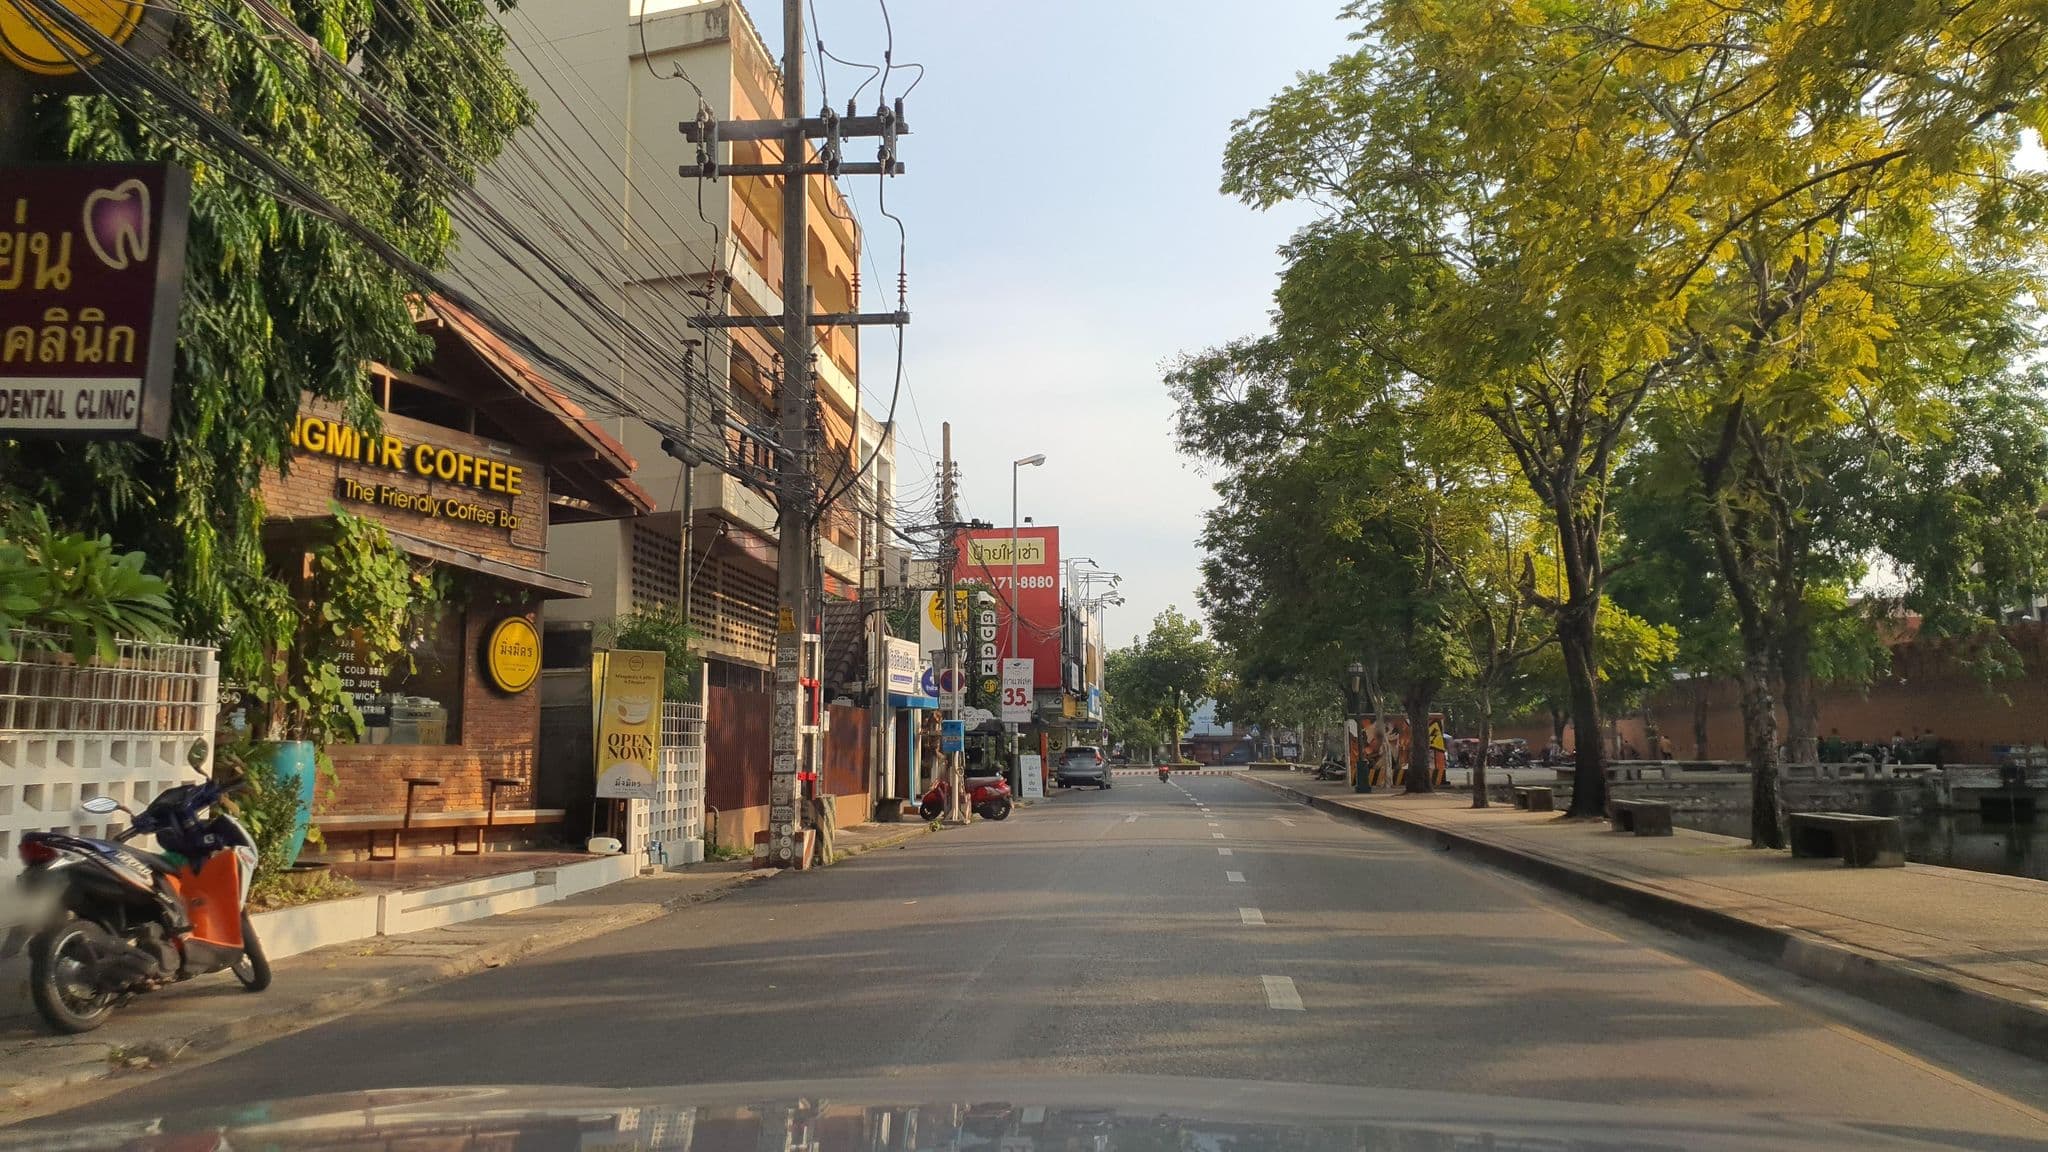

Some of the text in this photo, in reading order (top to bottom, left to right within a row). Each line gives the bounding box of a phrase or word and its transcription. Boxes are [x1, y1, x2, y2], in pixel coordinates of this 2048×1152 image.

[3, 306, 136, 364] คลินิก
[0, 388, 136, 420] DENTAL CLINIC
[414, 443, 523, 496] COFFEE
[345, 477, 522, 530] The Friendly Coffee Bar
[344, 666, 366, 676] COLD
[358, 680, 380, 689] JUICE
[607, 732, 654, 748] OPEN
[607, 746, 653, 761] NOW!
